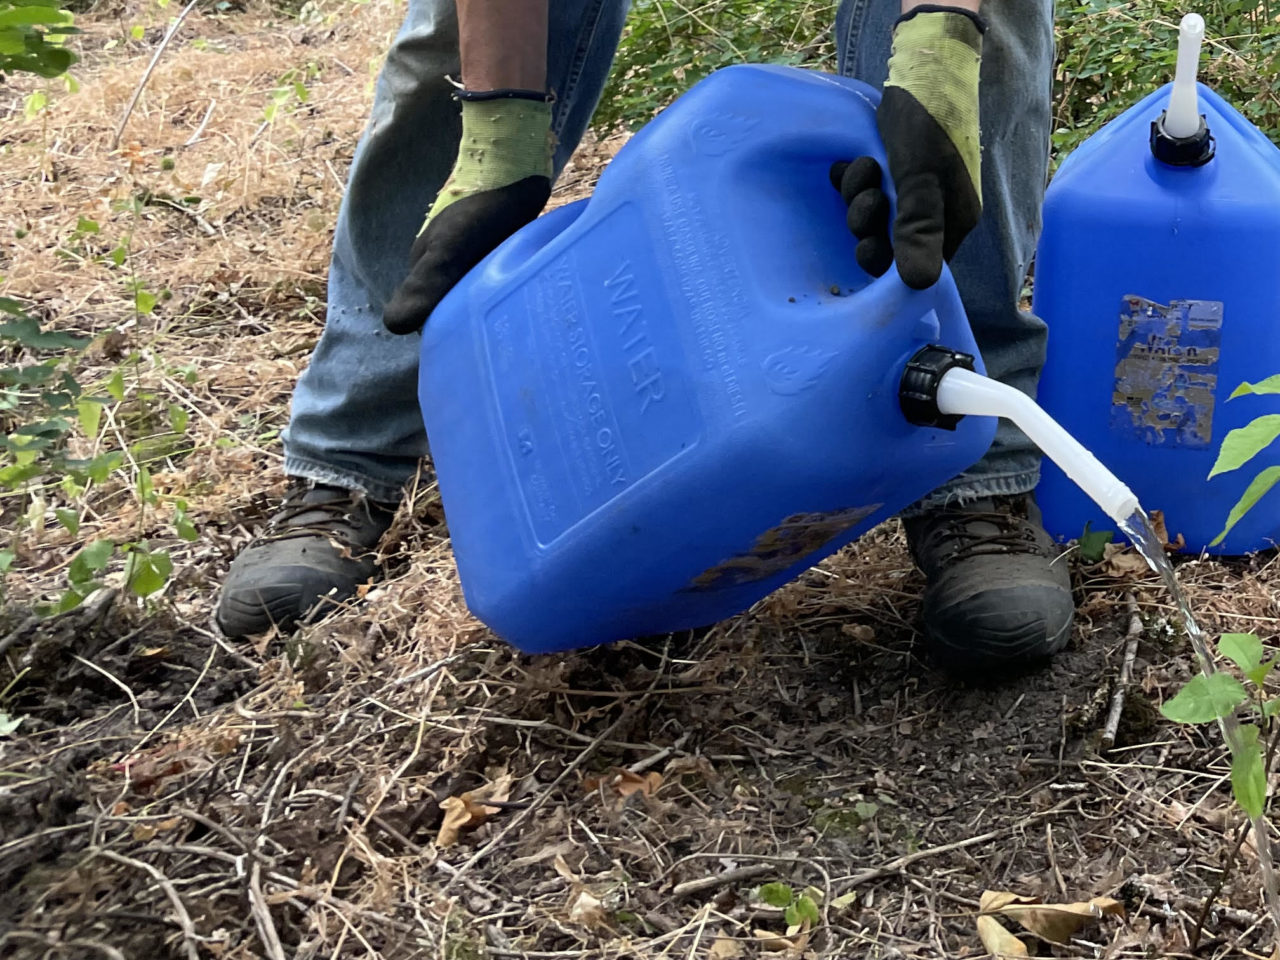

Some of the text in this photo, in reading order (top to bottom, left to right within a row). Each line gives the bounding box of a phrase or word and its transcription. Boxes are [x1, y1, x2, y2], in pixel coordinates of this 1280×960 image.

[551, 256, 584, 330] WATER
[602, 258, 667, 415] WATER
[566, 323, 609, 429] STORAGE
[593, 422, 627, 492] ONLY
